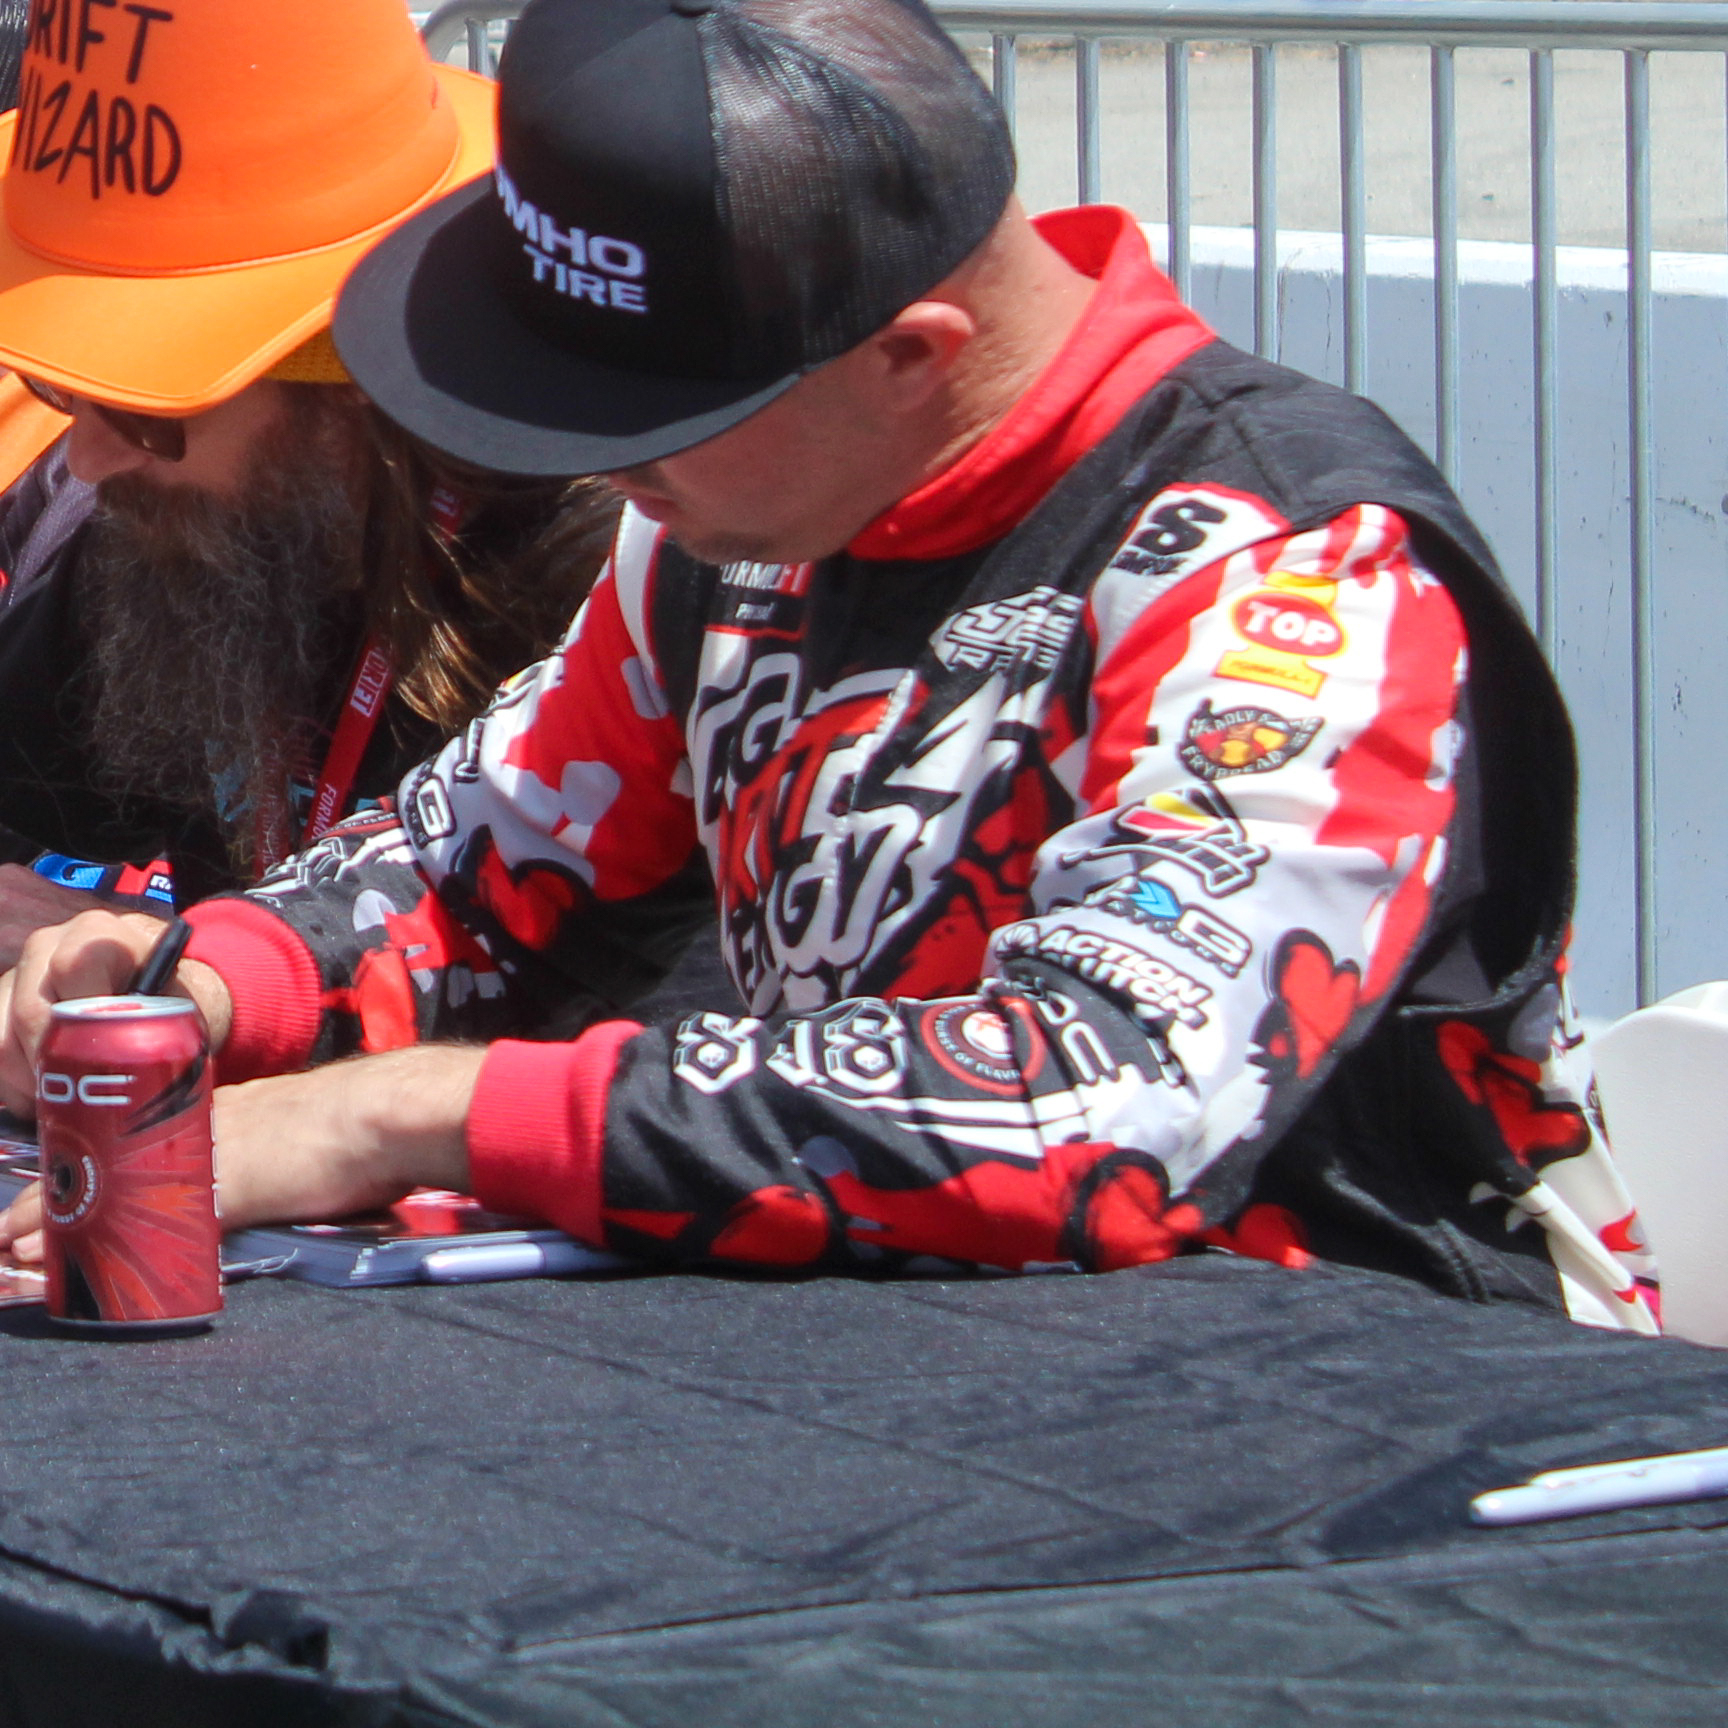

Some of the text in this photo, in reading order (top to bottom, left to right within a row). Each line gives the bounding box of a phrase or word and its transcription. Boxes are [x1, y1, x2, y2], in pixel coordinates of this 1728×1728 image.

[523, 242, 649, 316] TIRE
[1245, 600, 1338, 647] TOP
[1039, 925, 1213, 1005] ACTION
